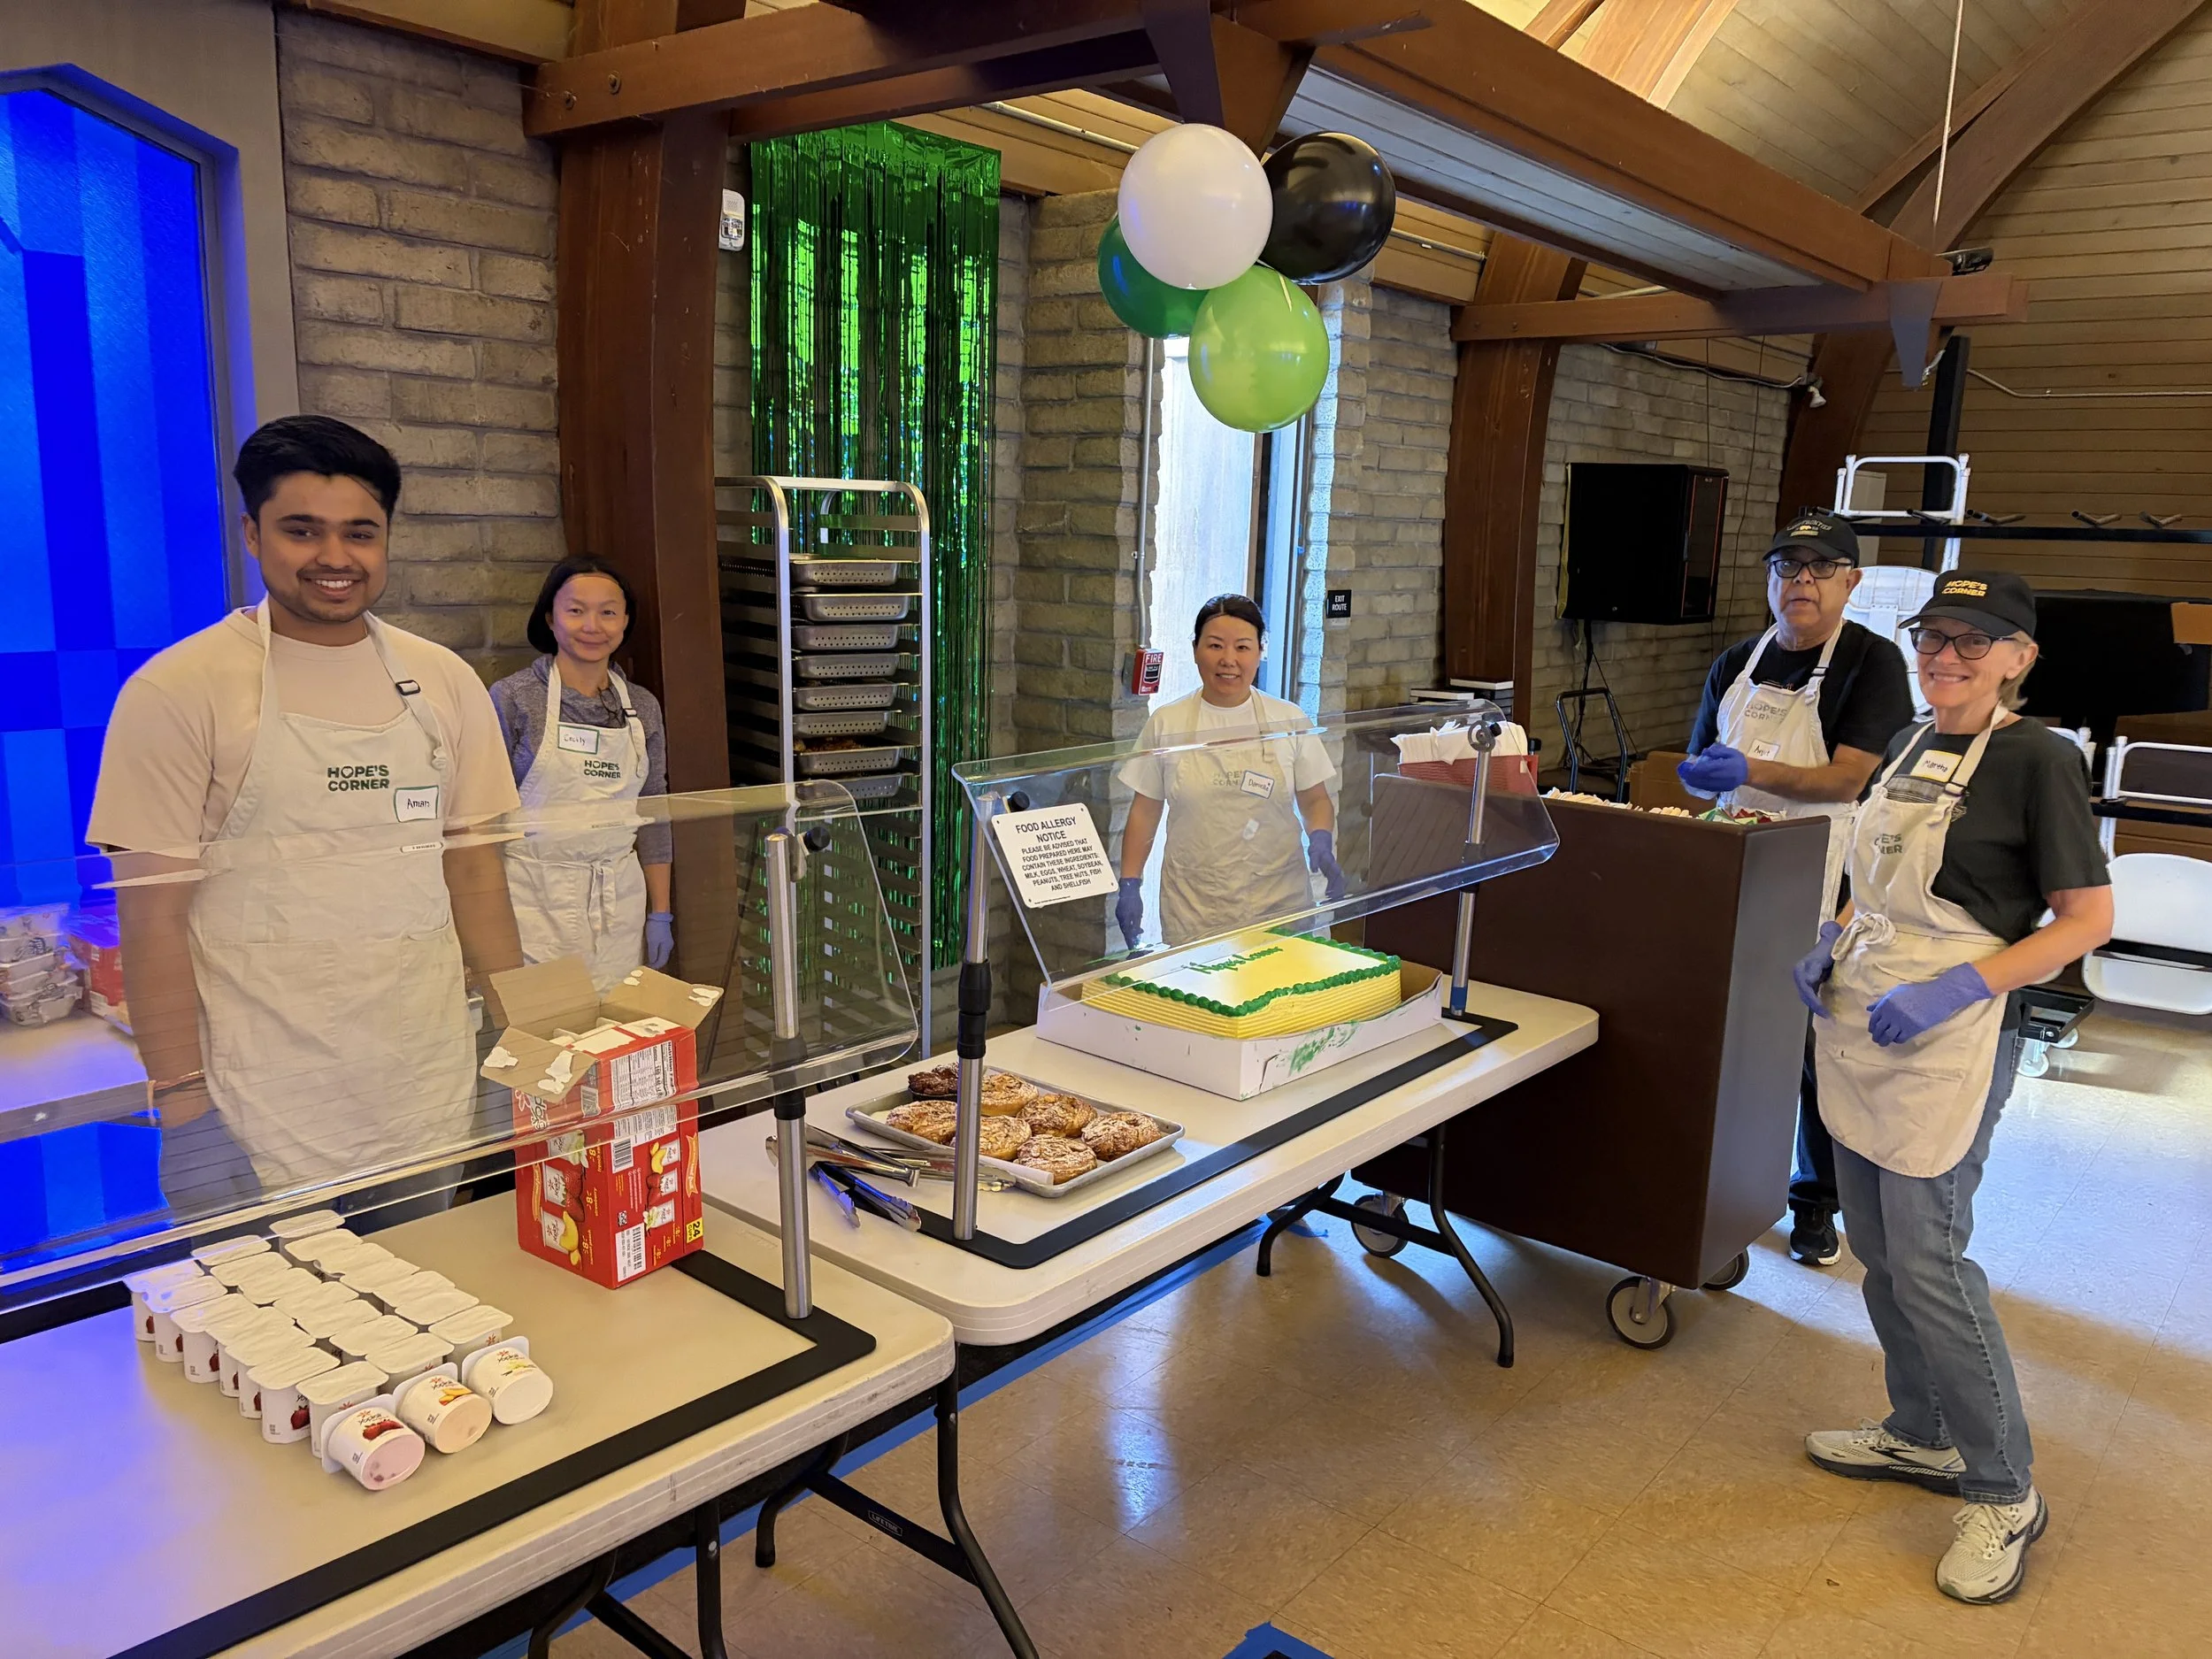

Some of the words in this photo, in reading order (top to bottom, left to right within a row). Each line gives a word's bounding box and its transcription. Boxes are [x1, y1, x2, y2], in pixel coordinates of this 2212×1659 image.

[1945, 580, 1987, 590] HOPE'S
[1942, 588, 1985, 596] CORNER
[1145, 654, 1162, 664] FIRE
[327, 764, 389, 779] HOPE'S
[584, 760, 620, 771] HOPE'S
[584, 769, 621, 779] CORNER
[328, 779, 390, 792] CORNER
[407, 798, 430, 810] Aman
[1016, 822, 1040, 833] FOOD
[1041, 817, 1077, 830] ALLERGY
[1036, 831, 1067, 843] NOTICE
[1021, 846, 1043, 855] PLEASE
[1052, 841, 1074, 849] ADVISED
[1039, 850, 1067, 860] PREPARED
[1022, 862, 1046, 872] CONTAIN
[1047, 858, 1064, 867] THESE
[1051, 883, 1063, 892] AND
[1064, 879, 1091, 889] SHELLFISH
[692, 1221, 701, 1237] 24
